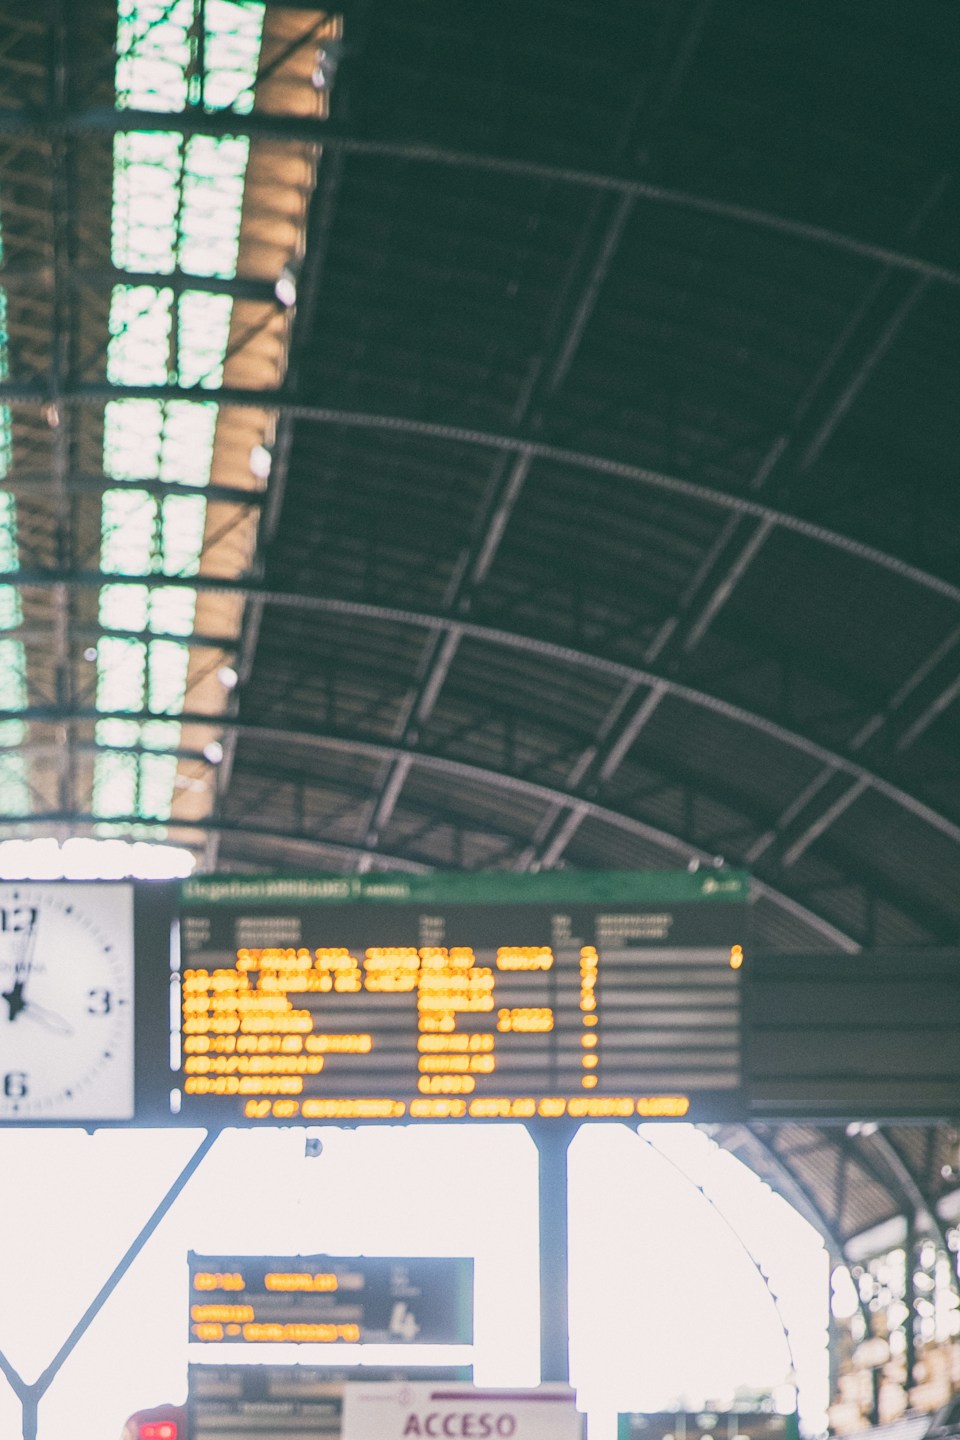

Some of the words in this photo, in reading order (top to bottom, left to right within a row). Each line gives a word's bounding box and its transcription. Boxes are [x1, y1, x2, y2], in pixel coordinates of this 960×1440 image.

[0, 908, 38, 932] 12
[88, 990, 111, 1015] 3
[4, 1073, 28, 1097] 6
[389, 1301, 420, 1341] 4
[402, 1411, 517, 1438] ACCESO
